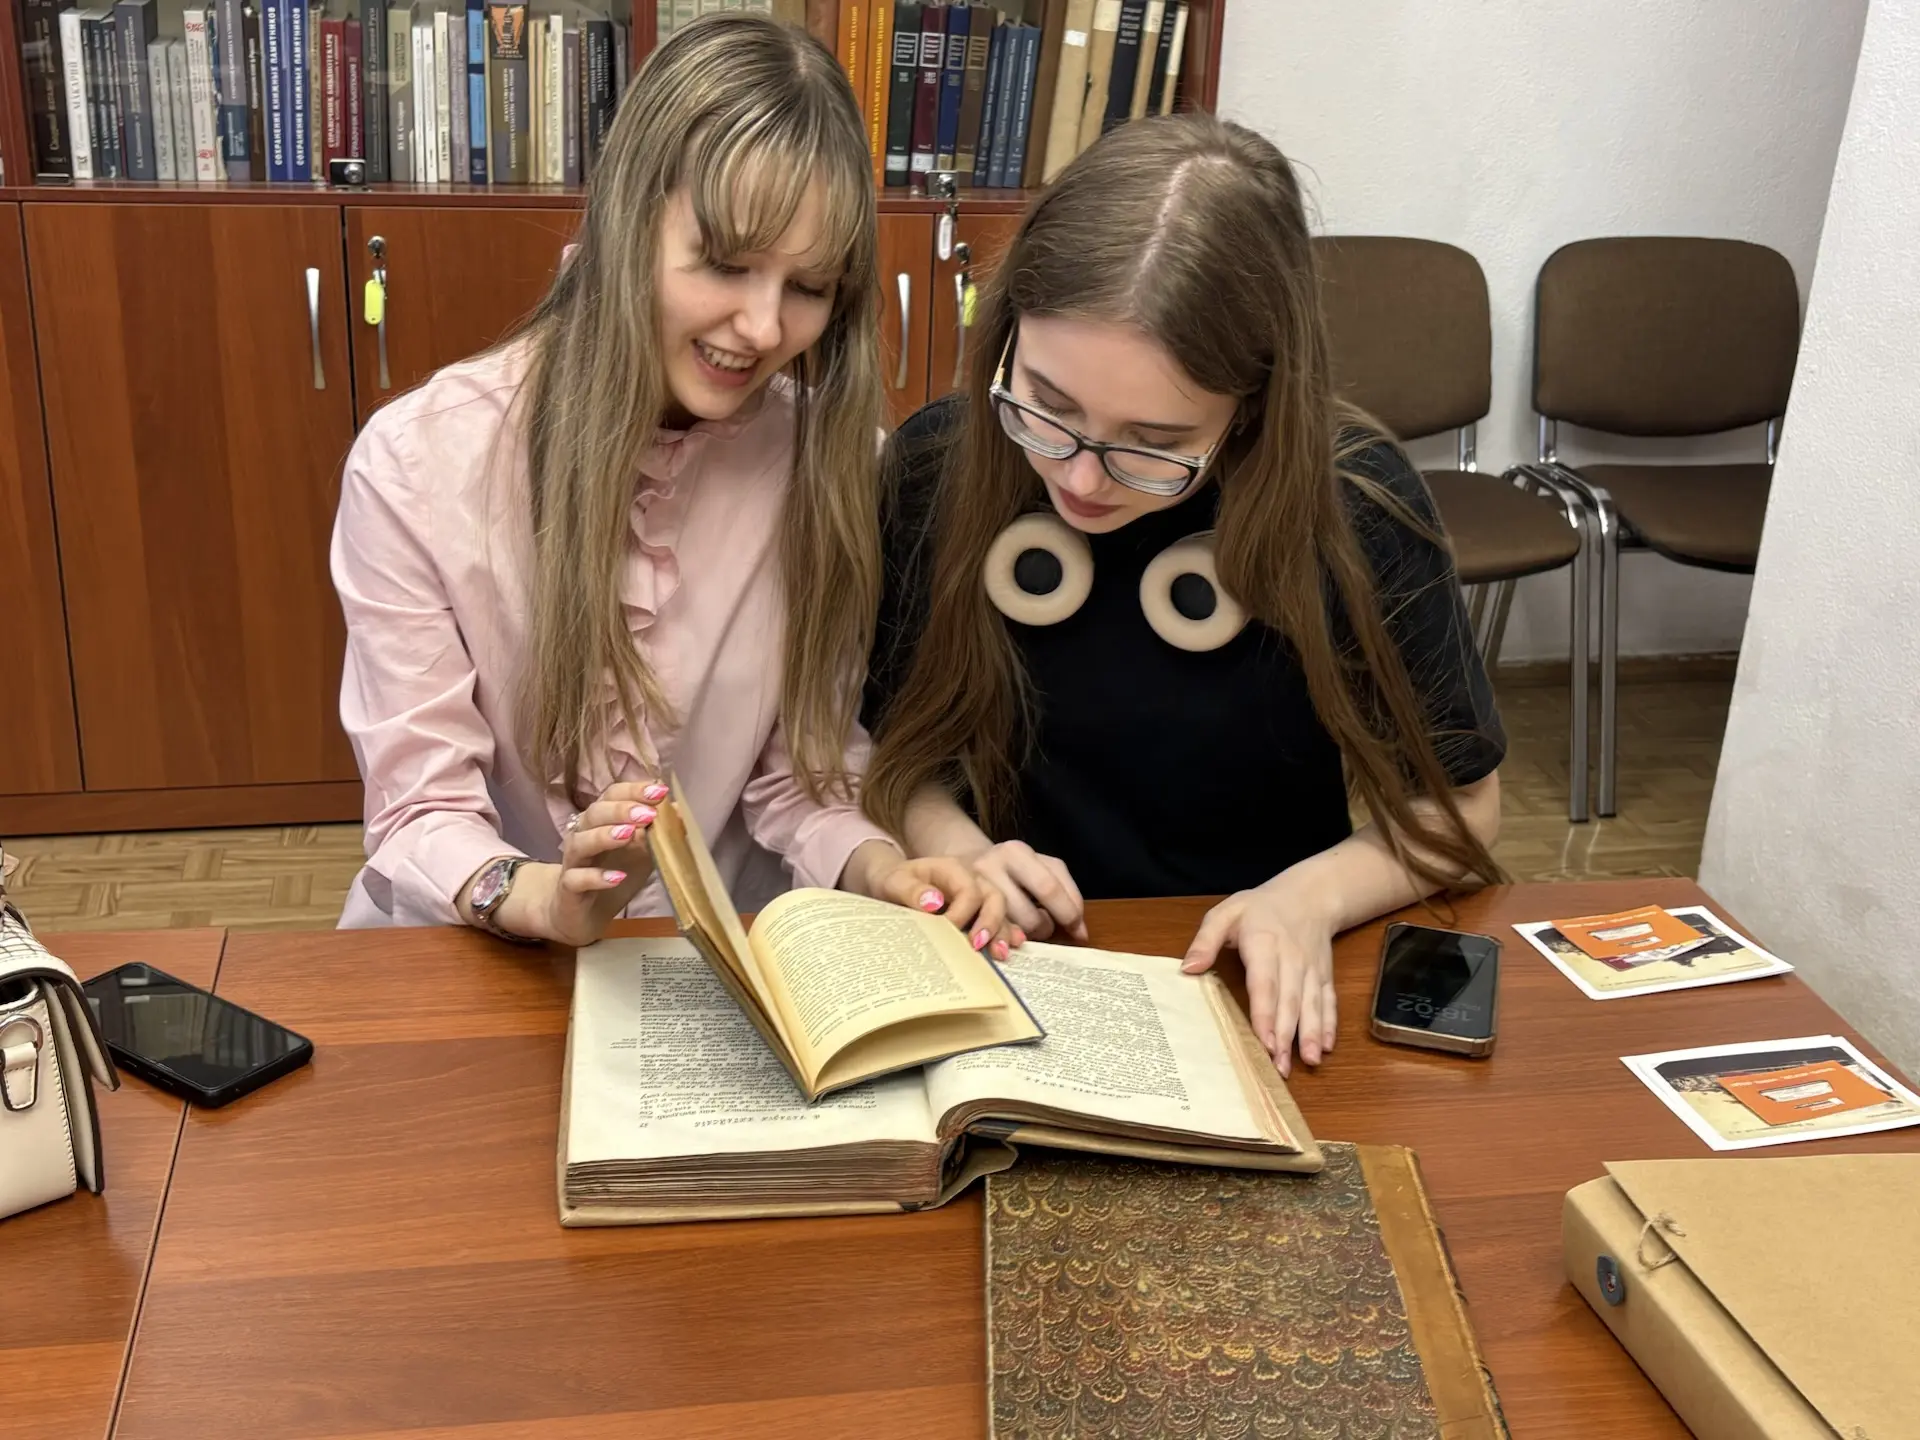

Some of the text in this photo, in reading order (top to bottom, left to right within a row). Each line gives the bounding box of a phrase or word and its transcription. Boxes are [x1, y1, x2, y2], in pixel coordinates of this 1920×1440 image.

[68, 61, 82, 110] МАКАРИЙ
[267, 6, 283, 166] СОХРАНЕНИЕ КНИЖНЫХ ПАМЯТНИКОВ
[292, 7, 305, 166] СОХРАНЕНИЕ КНИЖНЫХ ПАМЯТНИКОВ
[325, 33, 334, 148] СПРАВОЧНИК БИБЛИОТЕКАРЯ
[873, 91, 881, 121] КАТАЛОГ
[1396, 999, 1472, 1021] 18:02
